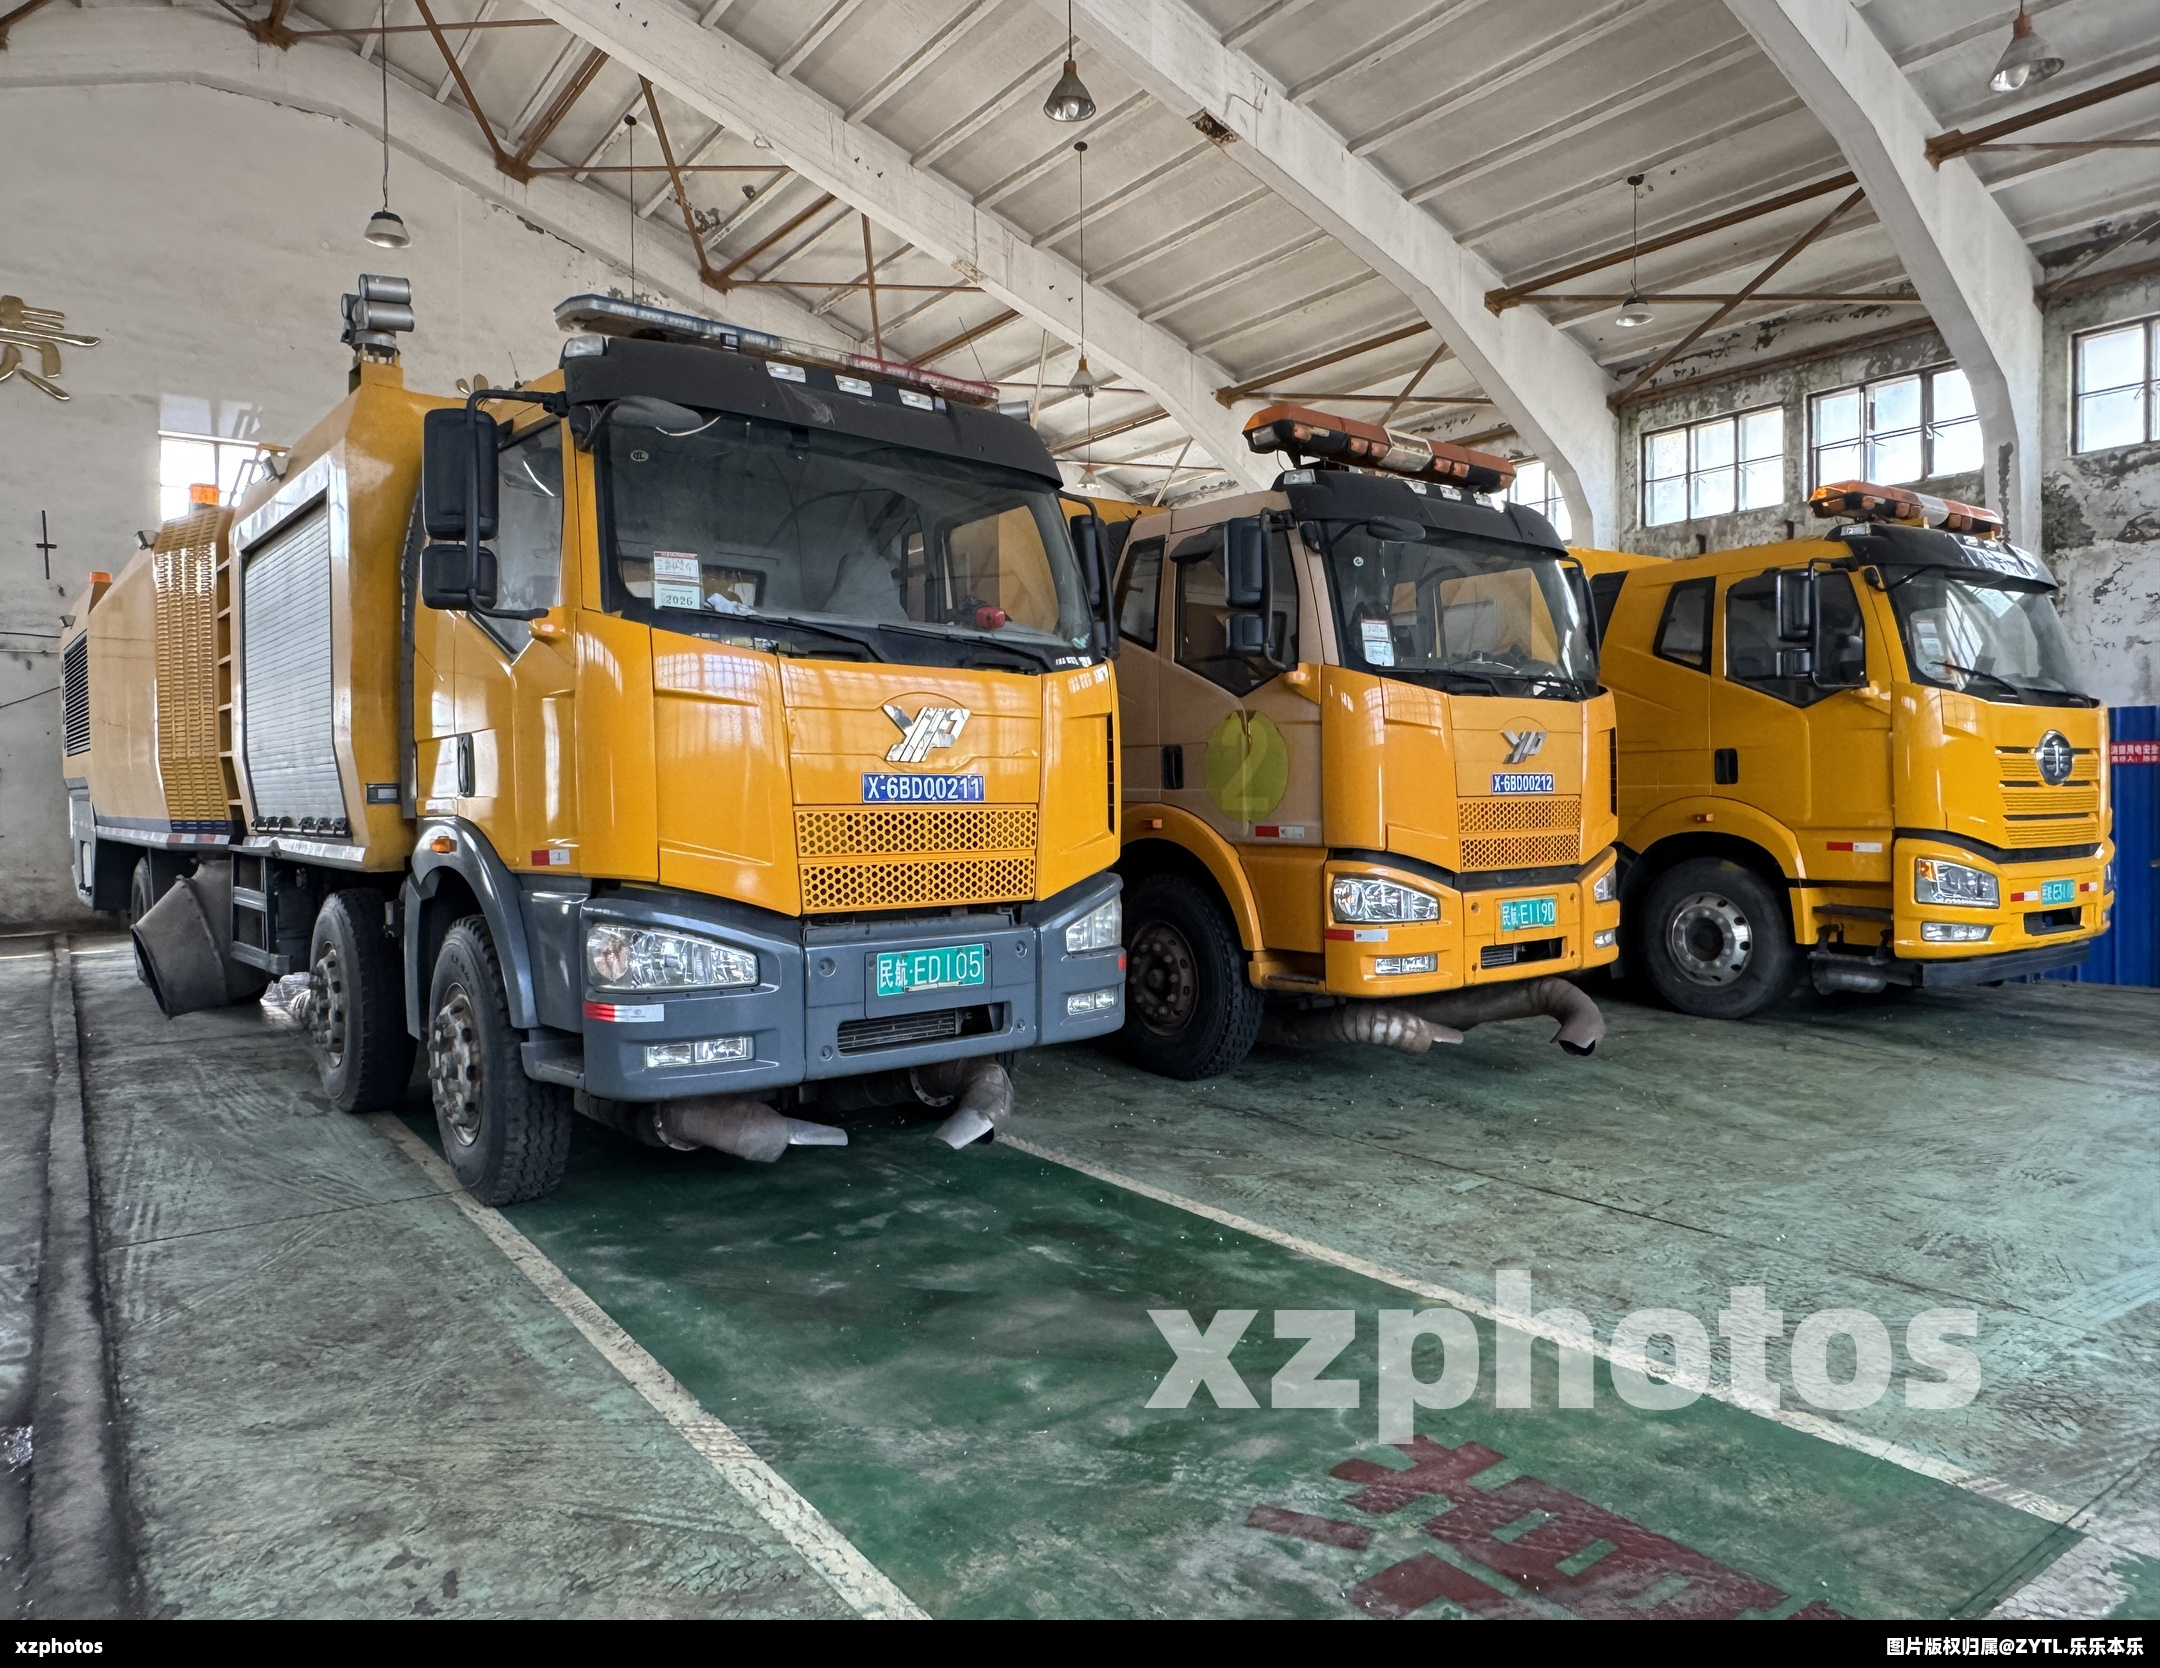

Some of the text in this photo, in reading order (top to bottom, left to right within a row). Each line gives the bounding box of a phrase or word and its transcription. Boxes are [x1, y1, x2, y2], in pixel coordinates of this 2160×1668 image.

[665, 594, 694, 606] 2026
[1220, 717, 1270, 812] 2
[867, 776, 980, 799] X-6BD00211
[1494, 775, 1553, 791] X-6BD00212
